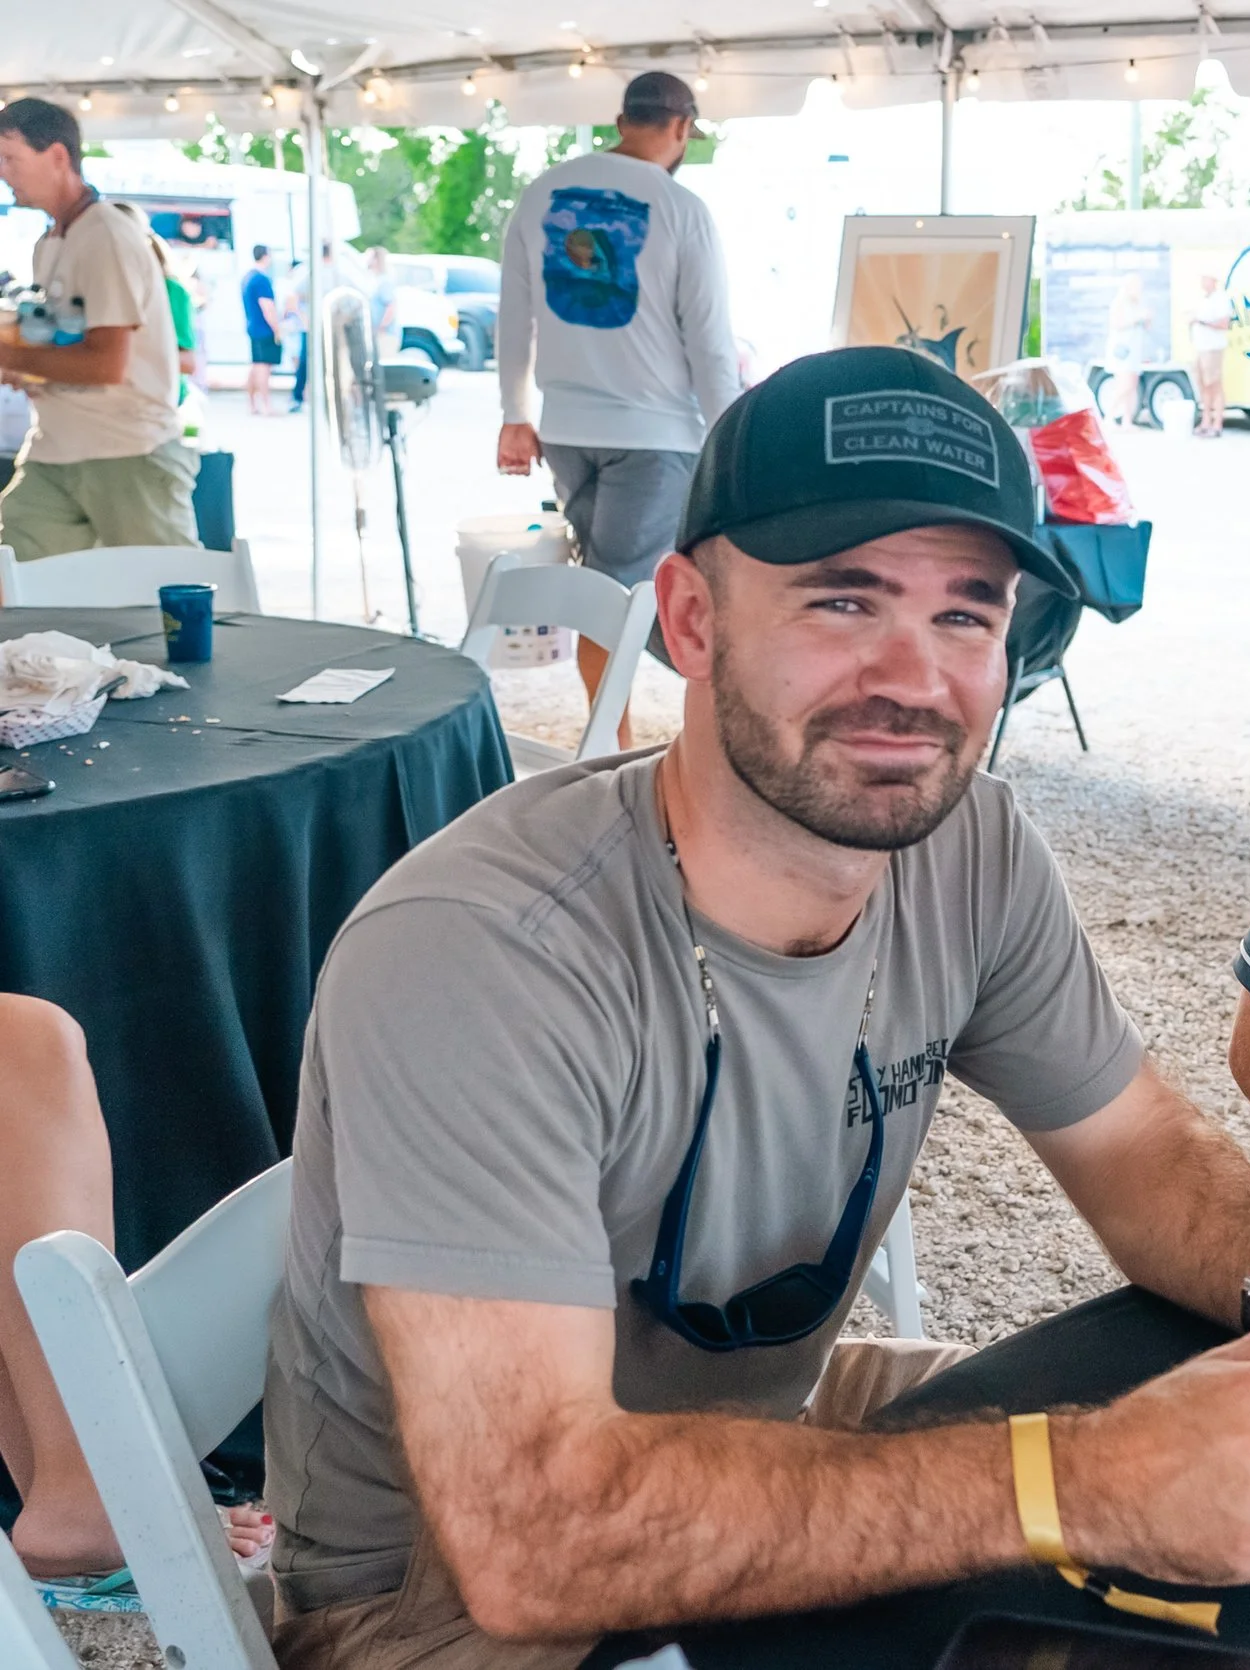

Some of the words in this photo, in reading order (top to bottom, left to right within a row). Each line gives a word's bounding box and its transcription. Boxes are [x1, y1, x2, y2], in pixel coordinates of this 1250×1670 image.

[843, 400, 948, 423] CAPTAINS
[952, 412, 984, 437] FOR
[844, 435, 919, 451] CLEAN
[925, 438, 986, 470] WATER
